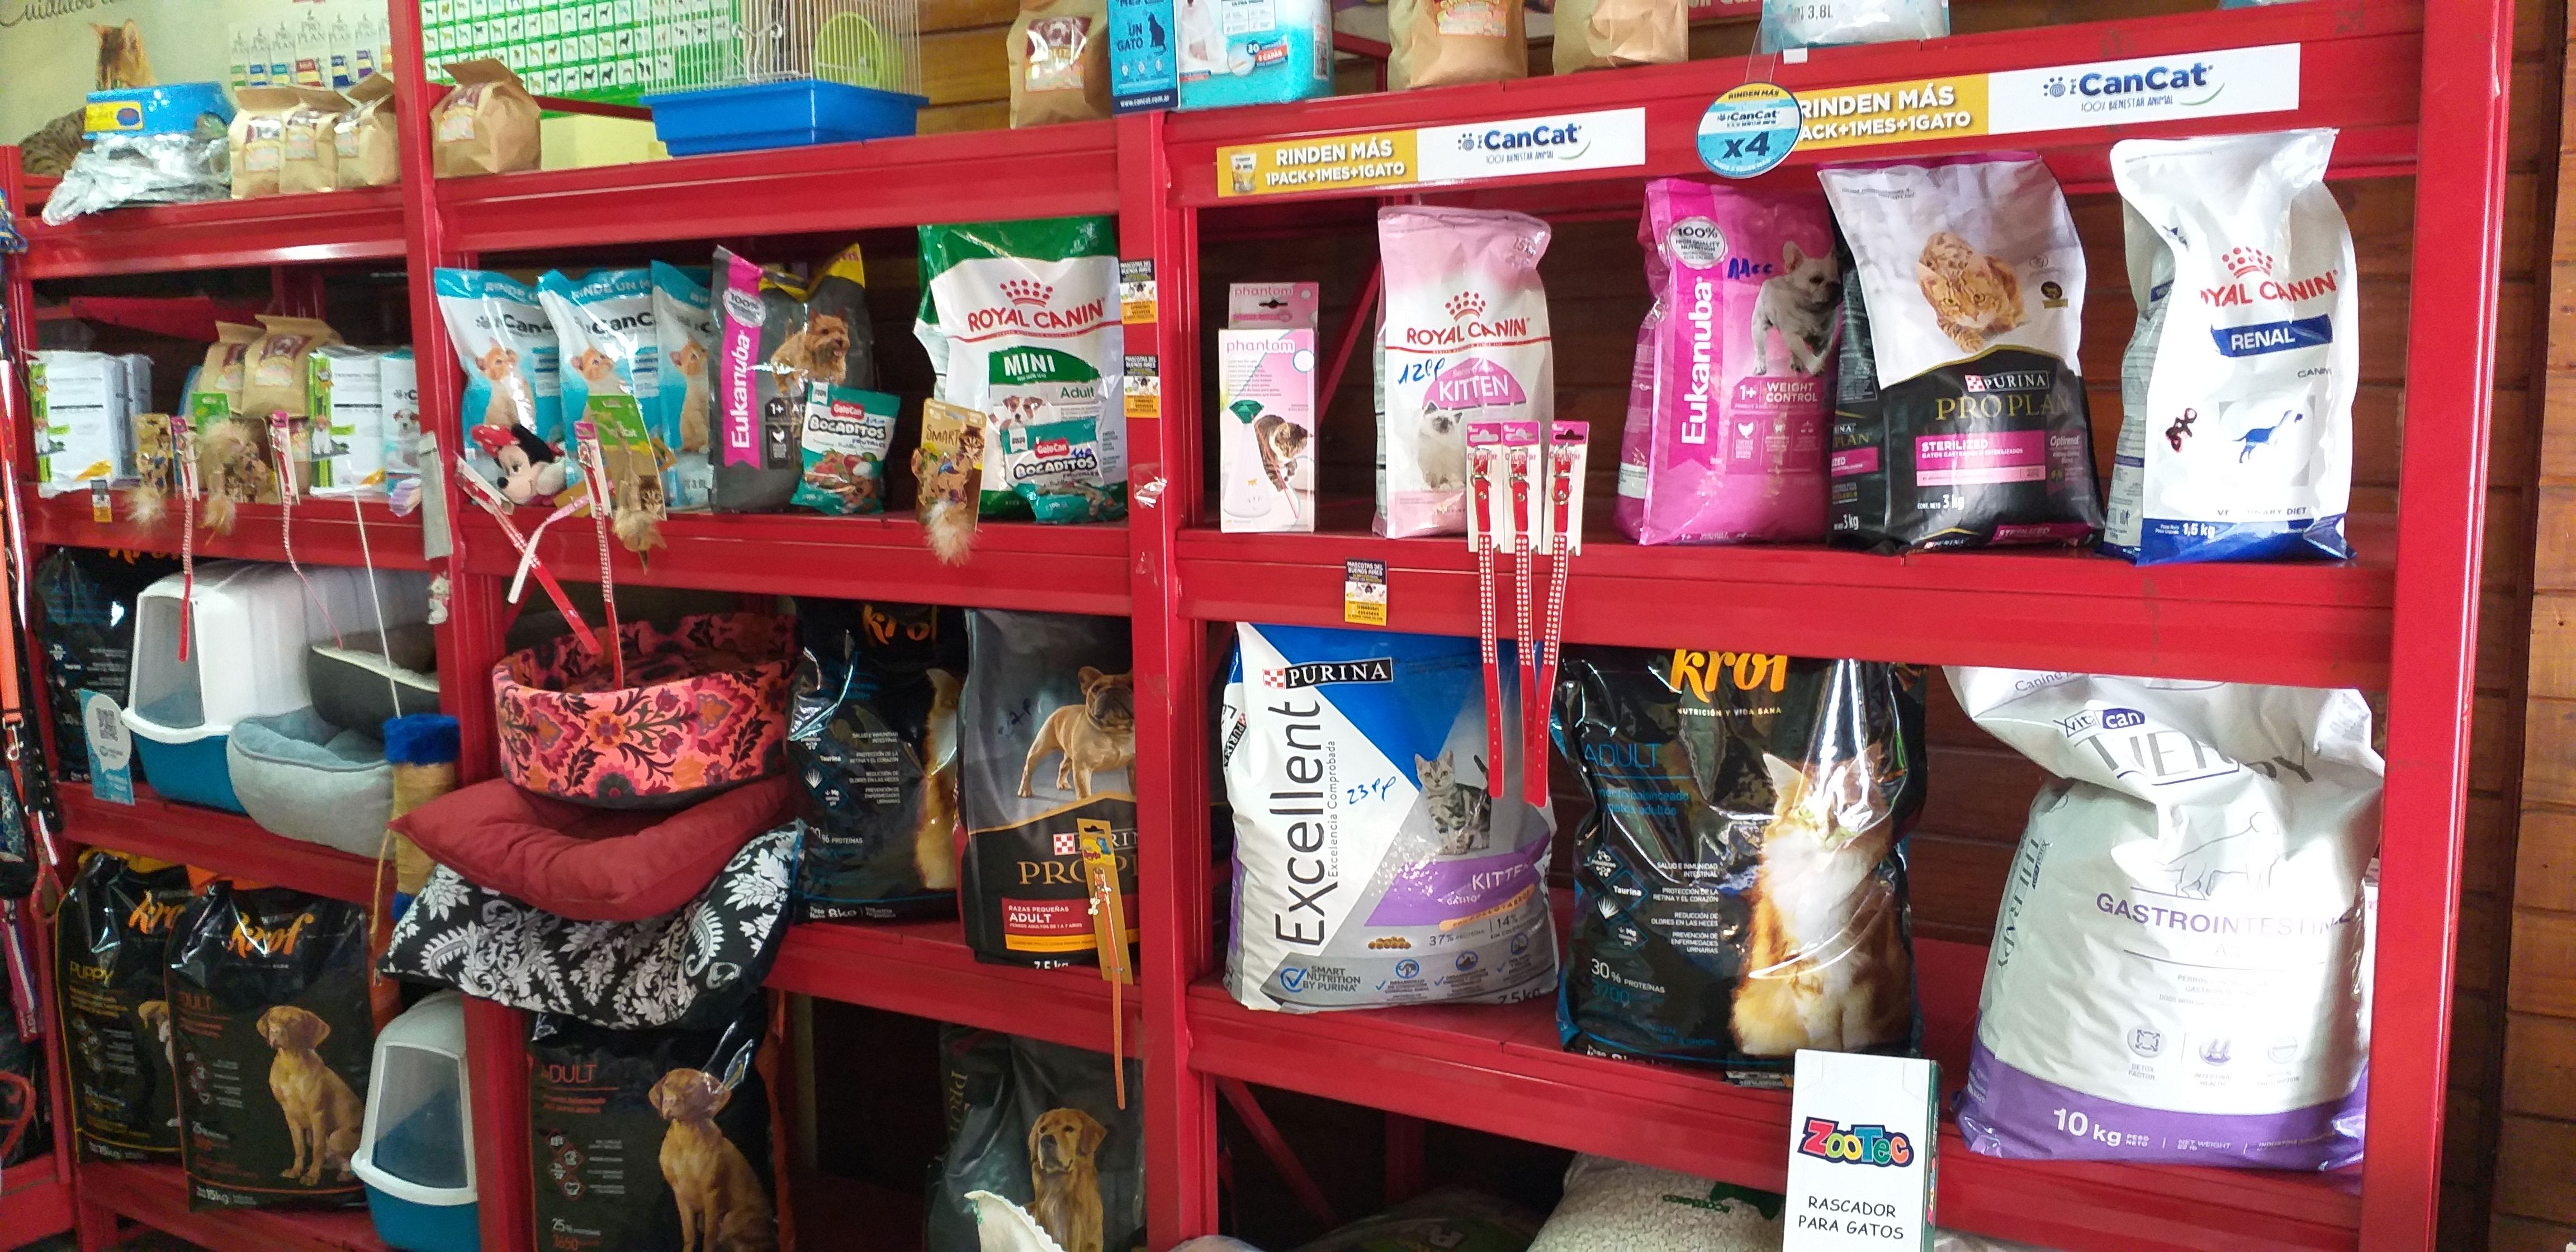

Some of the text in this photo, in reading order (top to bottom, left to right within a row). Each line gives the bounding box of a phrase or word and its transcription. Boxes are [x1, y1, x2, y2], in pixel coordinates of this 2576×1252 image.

[1128, 22, 1143, 37] UN
[1117, 37, 1143, 52] GATO
[2078, 62, 2207, 97] CanCat
[1728, 91, 1760, 99] RINDEN
[1898, 83, 1954, 109] MÁS
[2147, 95, 2174, 107] ANIMAL
[1730, 110, 1777, 121] CanCat
[1800, 112, 1971, 141] ACK+1MES+1GATO
[1484, 123, 1578, 150] CanCat
[1722, 131, 1770, 159] x4
[1276, 136, 1393, 167] RINDEN MÁS
[1265, 162, 1405, 186] 1PACK+1MES+1GATO
[1678, 226, 1718, 239] 100%
[1234, 286, 1294, 298] phantom
[2200, 271, 2337, 307] YAL CANIN
[968, 307, 1030, 333] ROYAL
[1033, 300, 1105, 329] CANIN
[1406, 317, 1527, 345] ROYAL CANIN
[2231, 327, 2296, 351] RENAL
[1226, 339, 1293, 354] phantom
[1003, 352, 1055, 376] MINI
[1681, 281, 1712, 445] Eukanuba
[730, 332, 750, 449] Eukanuba
[1438, 374, 1509, 402] KITTEN
[1983, 374, 2047, 390] PURINA
[1060, 386, 1095, 399] Adult
[1739, 382, 1815, 400] 1+ WEIGHT
[1765, 392, 1818, 403] CONTROL
[1935, 392, 2069, 420] PRO PLAN
[809, 414, 886, 440] BOCADITOS
[926, 424, 962, 447] SMART
[1037, 443, 1067, 454] GoloCan
[1921, 438, 1989, 452] STERILIZED
[1014, 453, 1097, 480] BOCADITOS
[1943, 494, 1965, 511] 3 kg
[2286, 506, 2307, 516] DIET
[1843, 514, 1859, 531] 3 kg
[2182, 522, 2216, 539] 1,5 kg
[1289, 662, 1389, 687] PURINA
[2015, 670, 2063, 693] Canine
[1677, 706, 1782, 717] NUTRICIÓN Y VIDA SANA
[2105, 710, 2142, 728] can
[1584, 743, 1663, 769] ADULT
[1326, 741, 1339, 878] Excelencia Comprobada
[1267, 699, 1338, 946] Excellent
[1613, 885, 1642, 897] Taurina
[1662, 886, 1699, 895] PROTECCIÓN
[1009, 913, 1052, 923] ADULT
[1429, 933, 1454, 946] 37%
[1672, 931, 1709, 939] PREVENCIÓN
[1306, 973, 1361, 984] NUTRITION
[1311, 965, 1346, 975] SMART
[1303, 981, 1356, 992] BY PURINA
[1623, 978, 1666, 994] PROTEÍNAS
[2177, 974, 2208, 984] PERROS
[2128, 1070, 2156, 1081] FACTOR
[2131, 1063, 2154, 1073] DETOX
[2053, 1108, 2089, 1137] 10
[2093, 1123, 2122, 1147] kg
[2197, 1141, 2232, 1149] WEIGHT
[1808, 1195, 1896, 1218] RASCADOR
[1798, 1215, 1904, 1240] PARA GATOS
